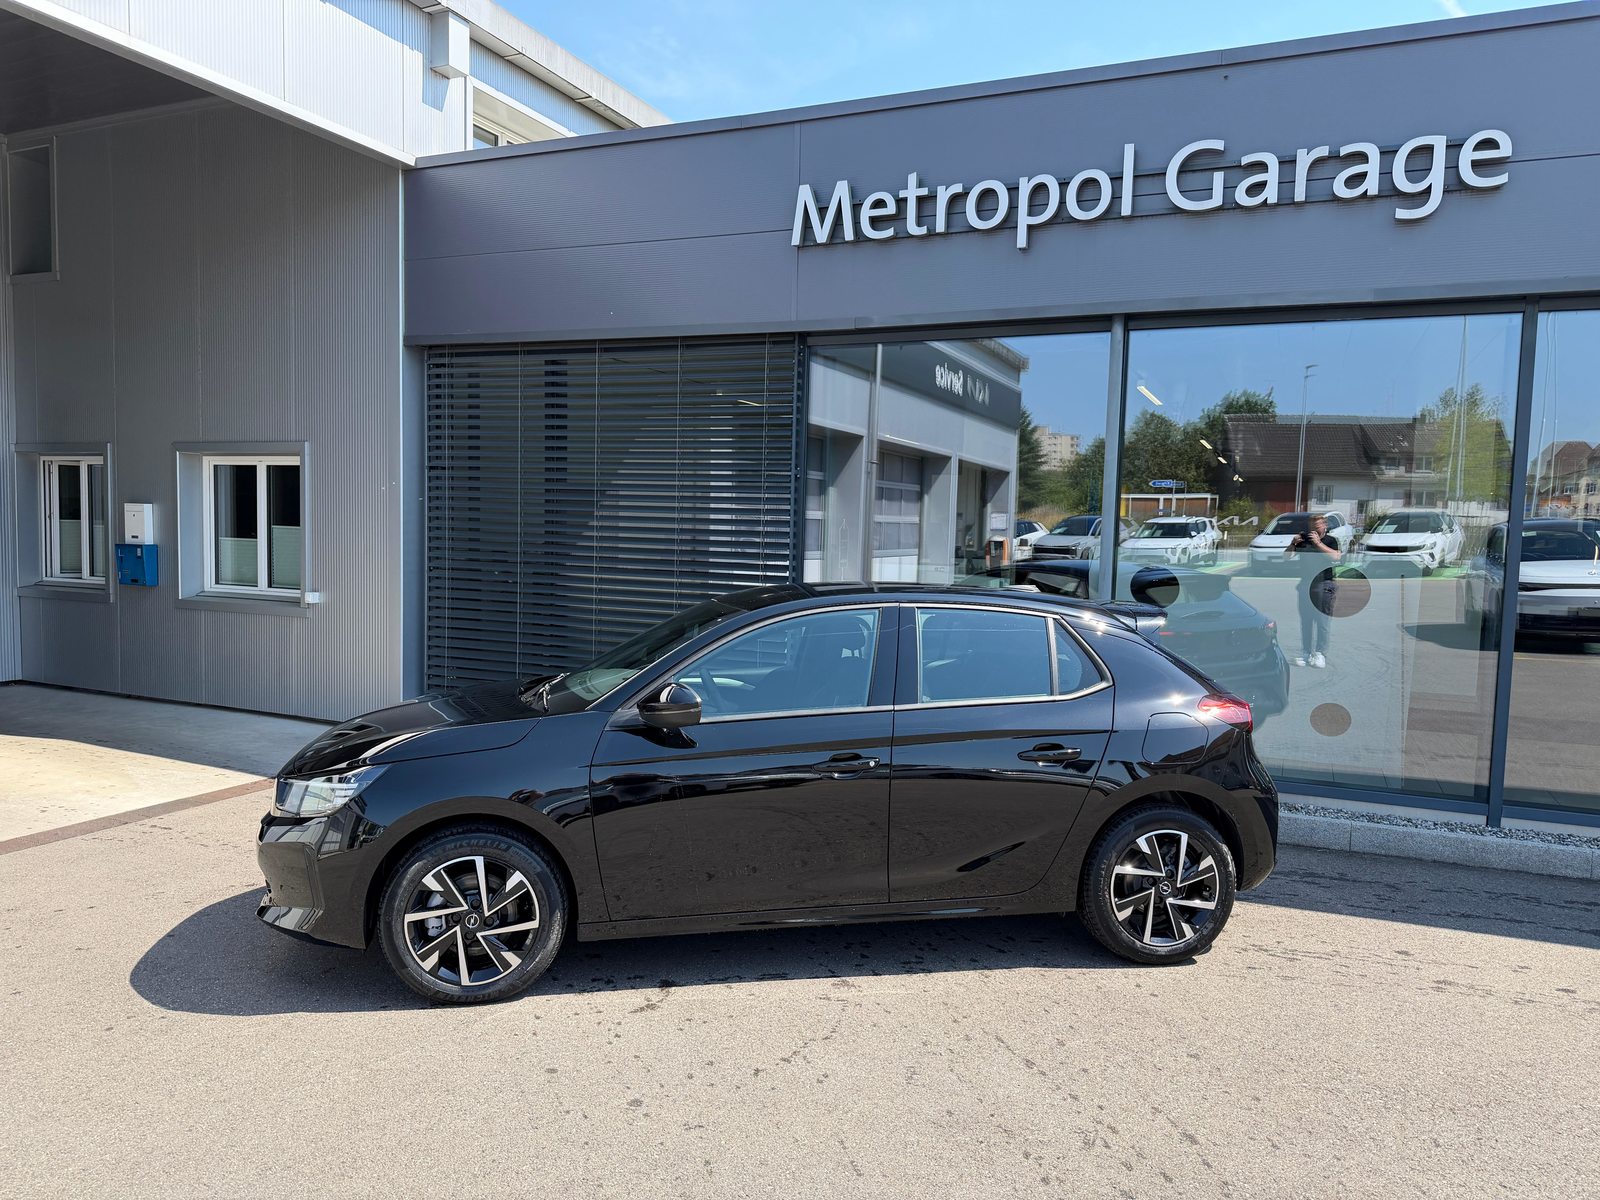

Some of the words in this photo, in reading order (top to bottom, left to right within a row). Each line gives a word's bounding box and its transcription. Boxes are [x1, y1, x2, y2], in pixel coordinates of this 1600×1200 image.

[791, 143, 1135, 249] Metropol
[1165, 129, 1513, 219] Garage
[446, 839, 508, 849] MICHELIN
